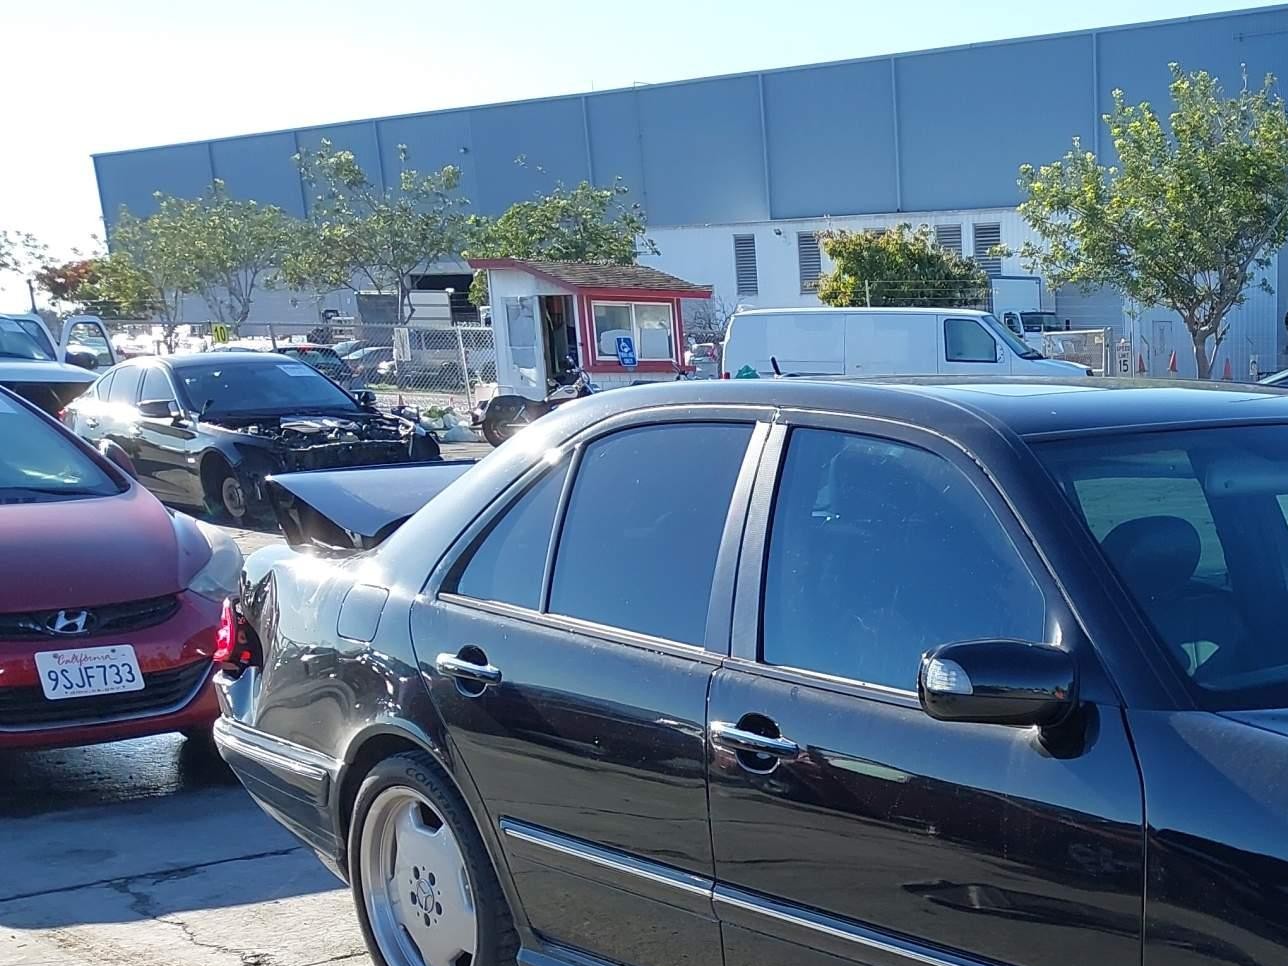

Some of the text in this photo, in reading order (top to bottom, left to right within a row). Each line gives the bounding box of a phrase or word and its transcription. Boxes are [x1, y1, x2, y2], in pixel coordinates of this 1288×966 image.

[214, 326, 226, 342] 10
[1119, 359, 1129, 372] 15
[57, 652, 116, 666] California
[47, 662, 136, 692] 9SJF733
